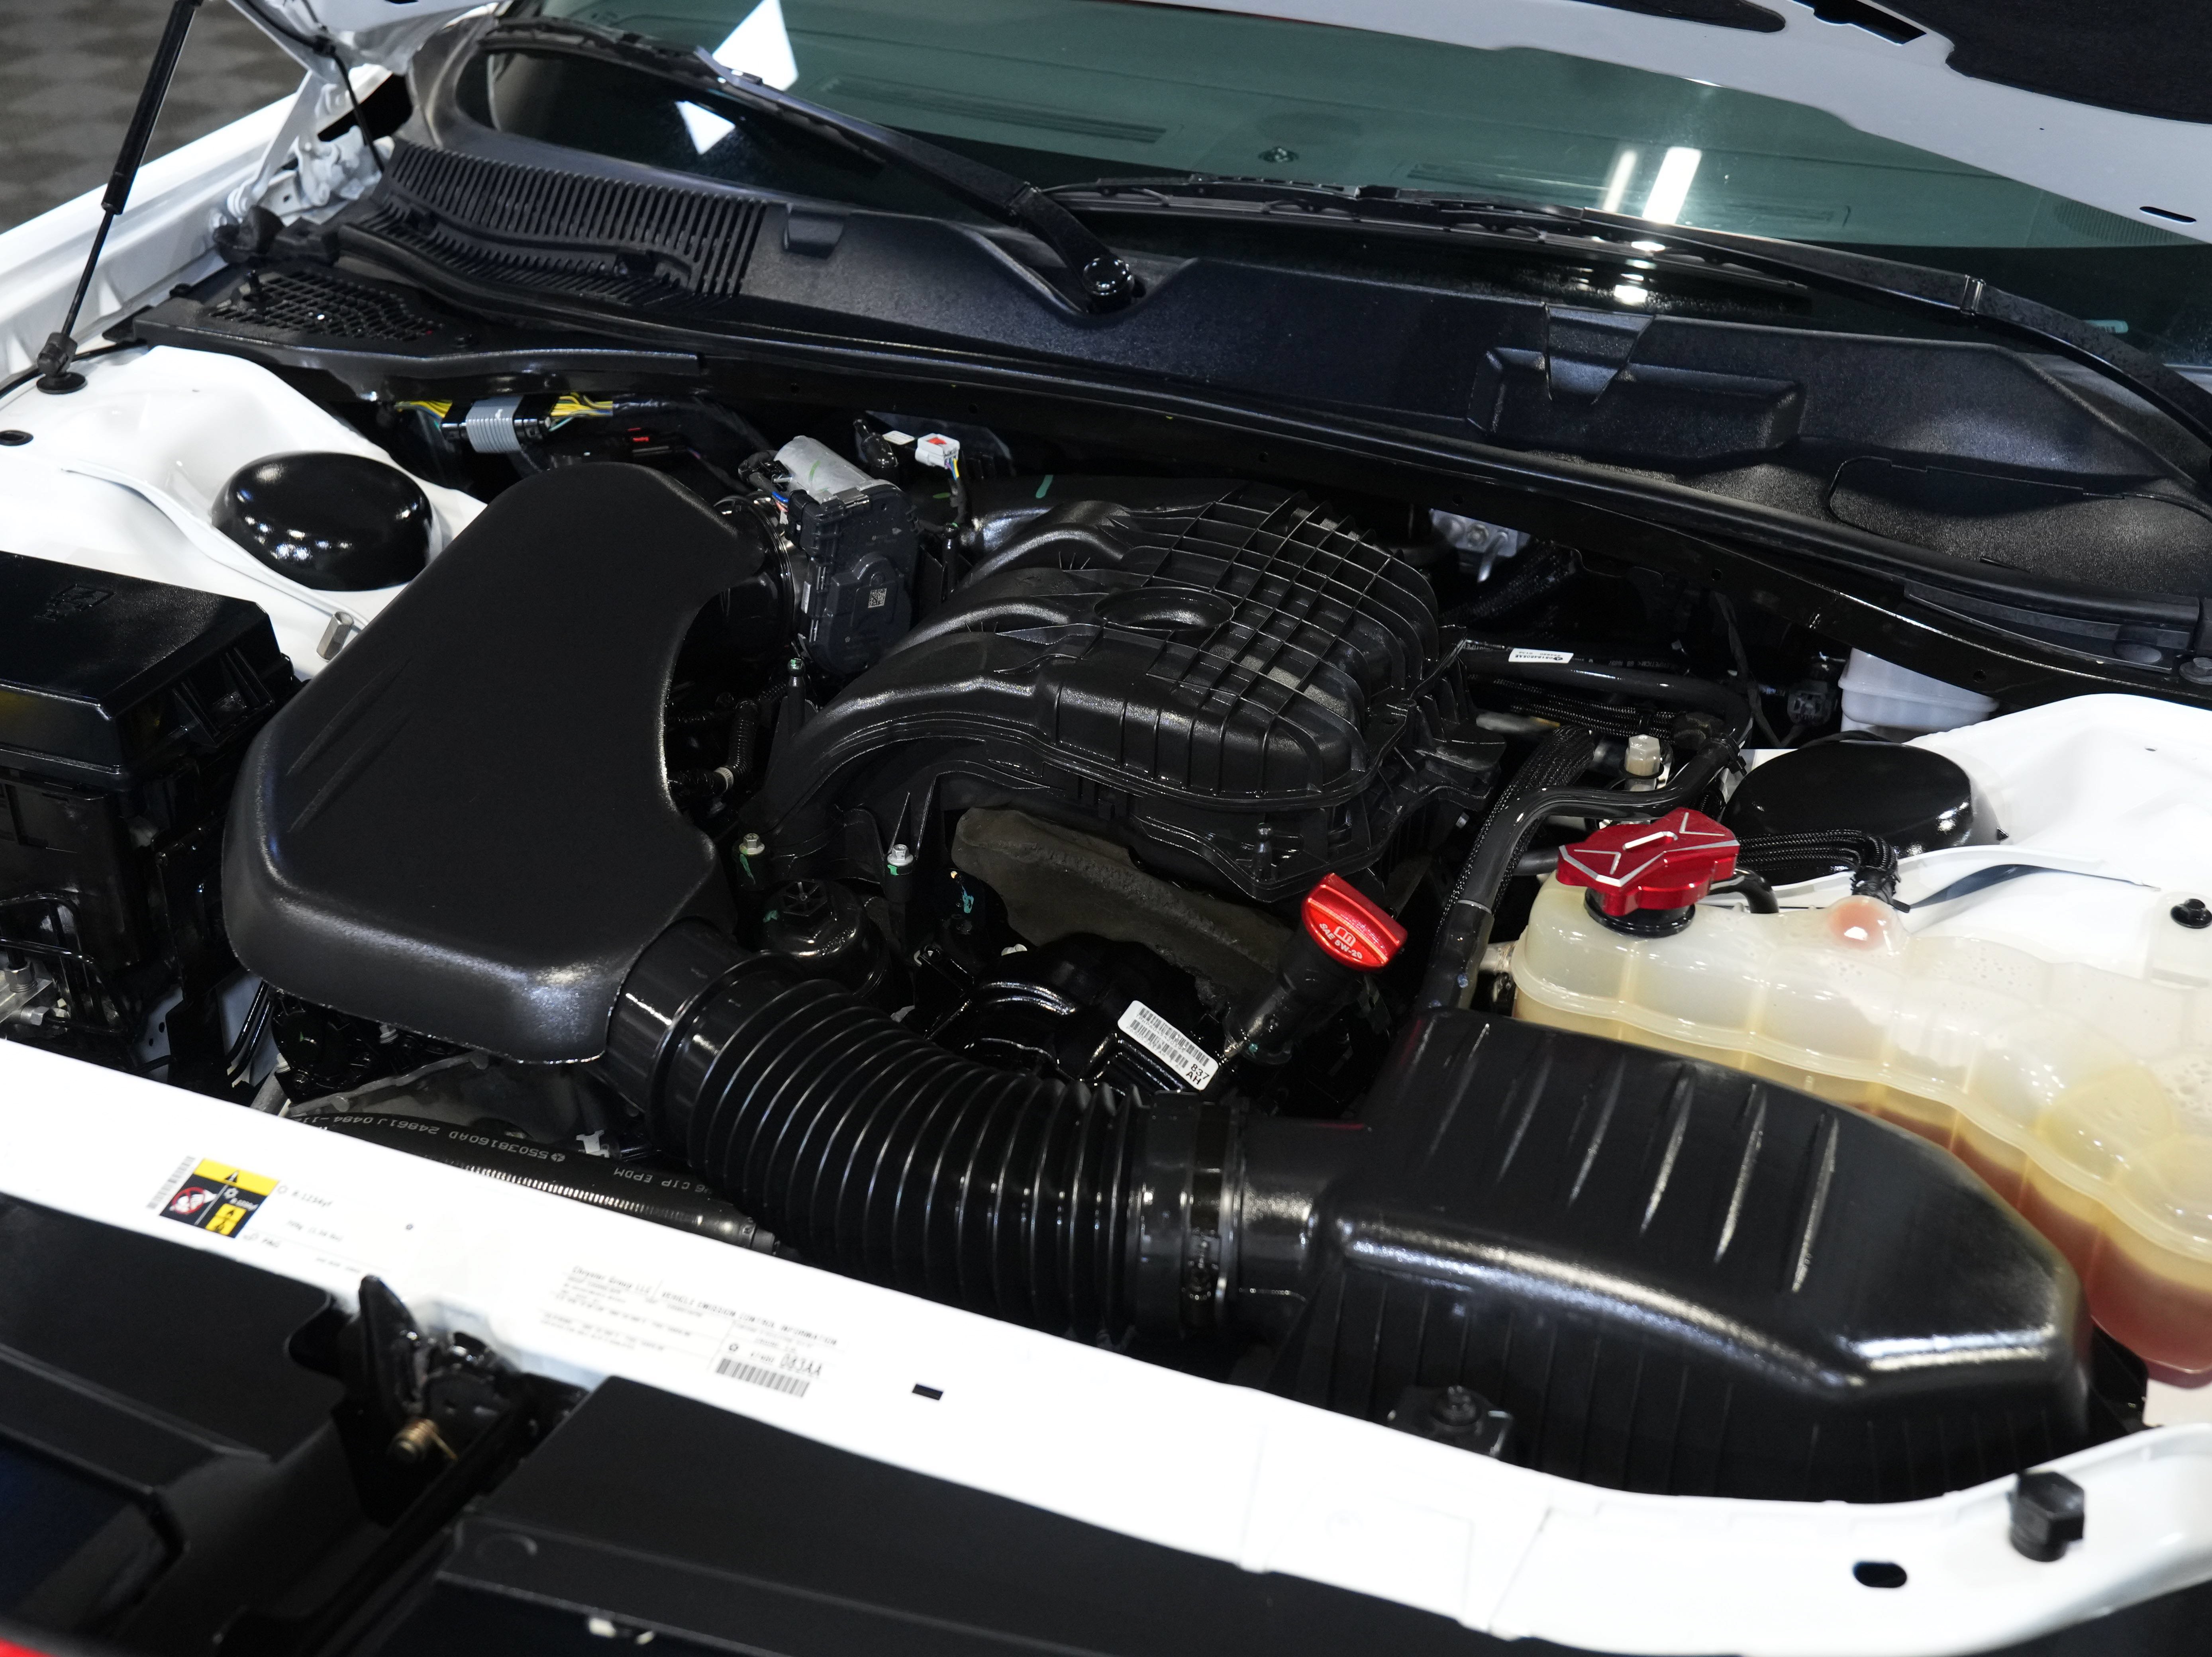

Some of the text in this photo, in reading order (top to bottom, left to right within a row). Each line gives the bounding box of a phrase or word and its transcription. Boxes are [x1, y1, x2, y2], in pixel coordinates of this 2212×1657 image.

[1319, 923, 1363, 959] SAE 5W-20
[1186, 1071, 1202, 1085] AH
[1191, 1064, 1210, 1079] 837
[449, 1131, 549, 1160] 55038160AD
[614, 1168, 653, 1183] EPDM
[697, 1301, 736, 1317] EMISSION
[780, 1324, 837, 1346] INFORMATION
